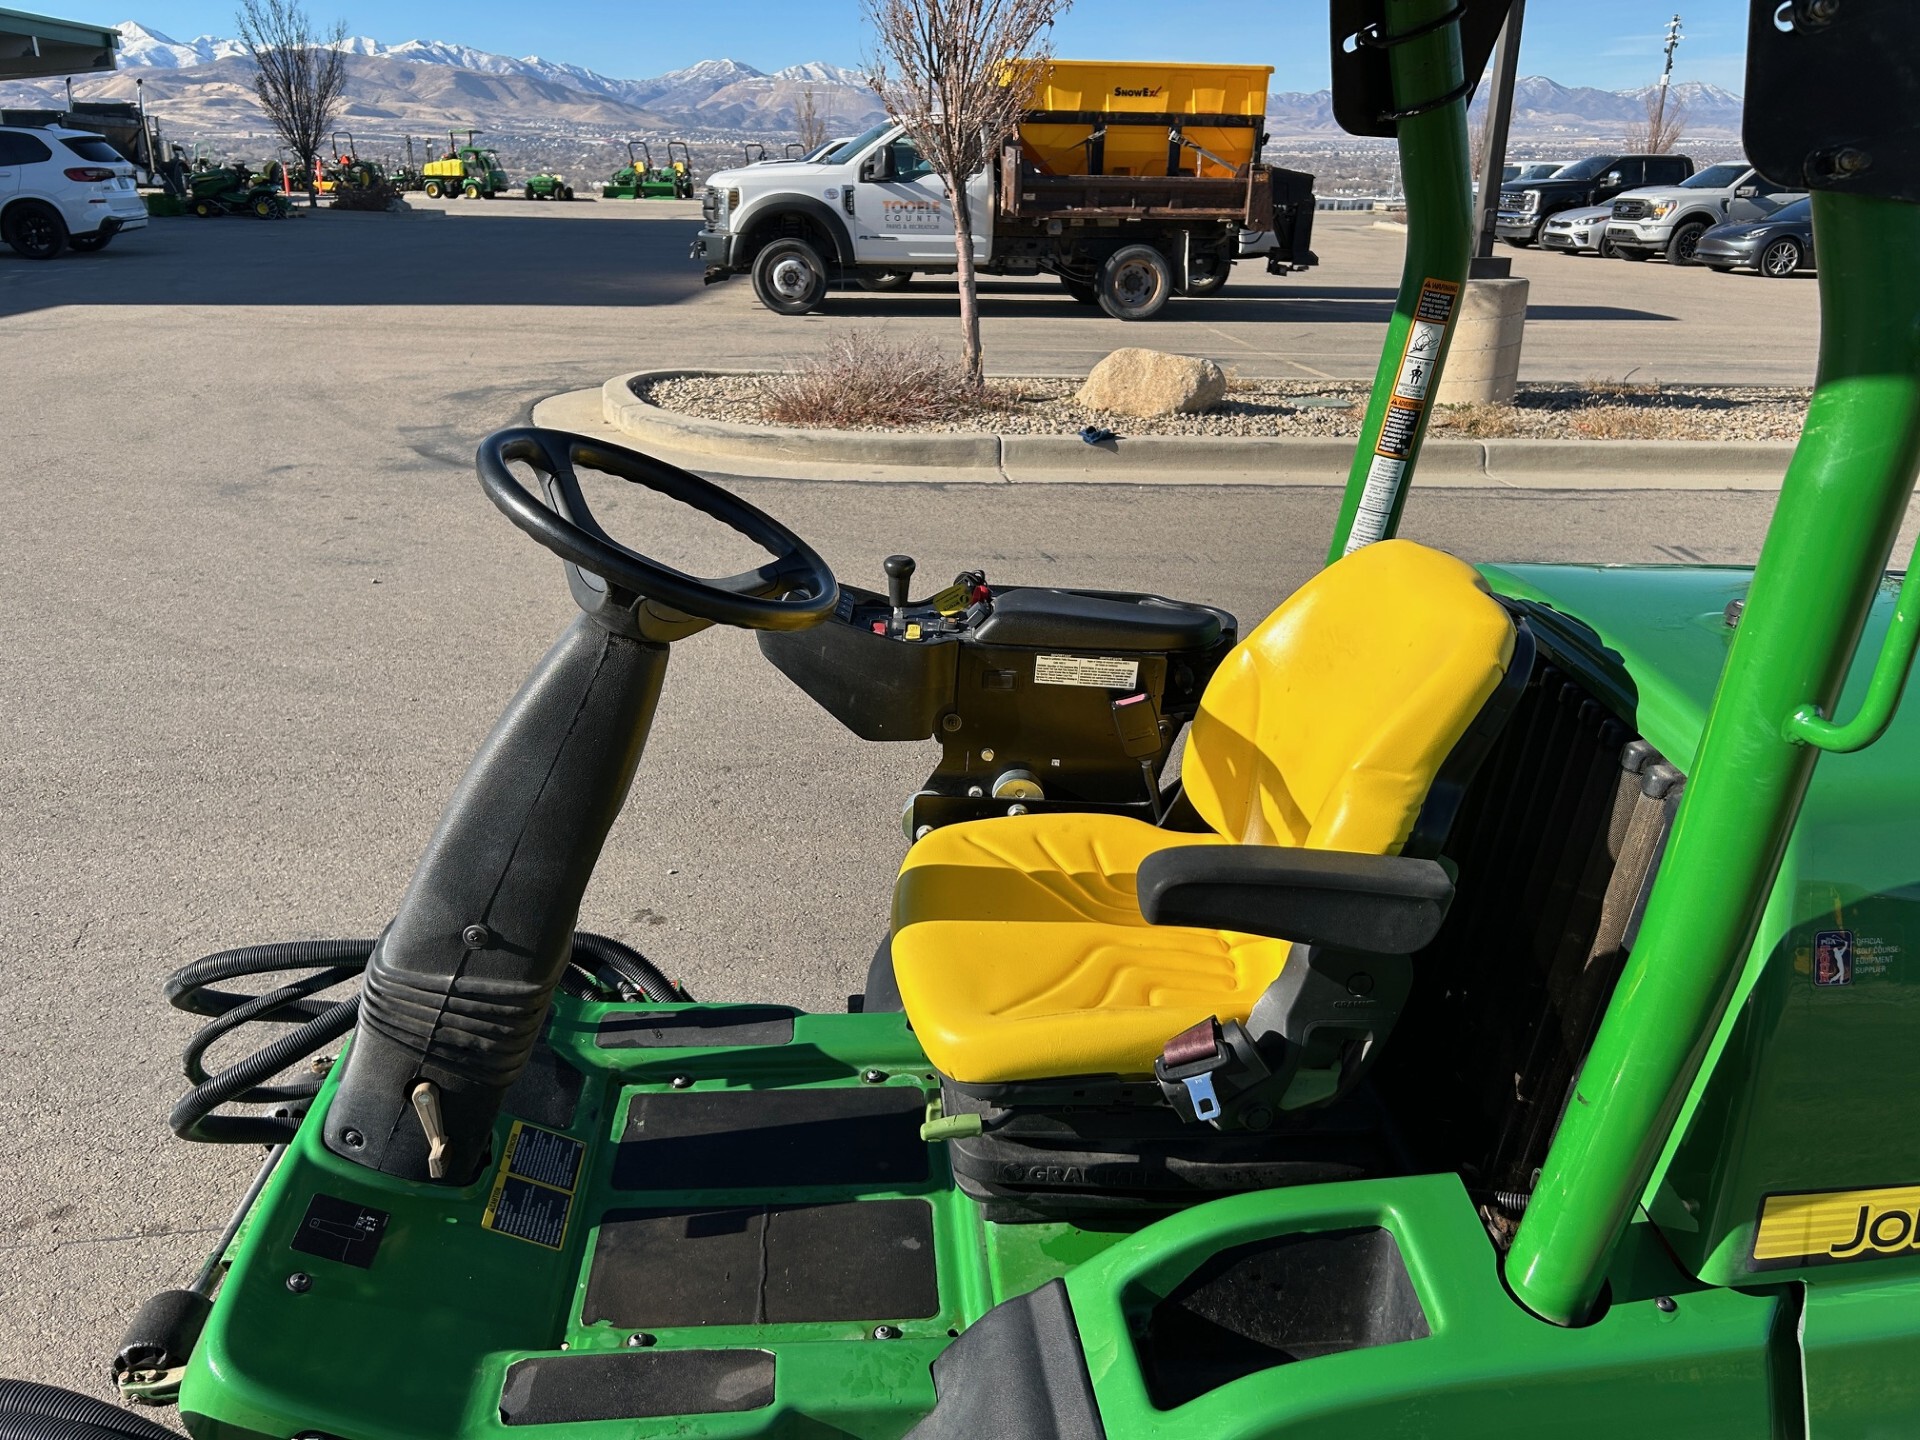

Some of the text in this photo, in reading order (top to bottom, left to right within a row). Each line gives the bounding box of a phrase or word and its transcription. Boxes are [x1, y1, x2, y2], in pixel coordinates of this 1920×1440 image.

[884, 214, 941, 222] COUNTY
[1431, 281, 1458, 292] WARNING
[1856, 937, 1884, 945] OFFICIAL
[1873, 945, 1899, 954] COURSE
[1855, 955, 1894, 965] EQUIPMENT
[1855, 965, 1887, 974] SUPPLIER
